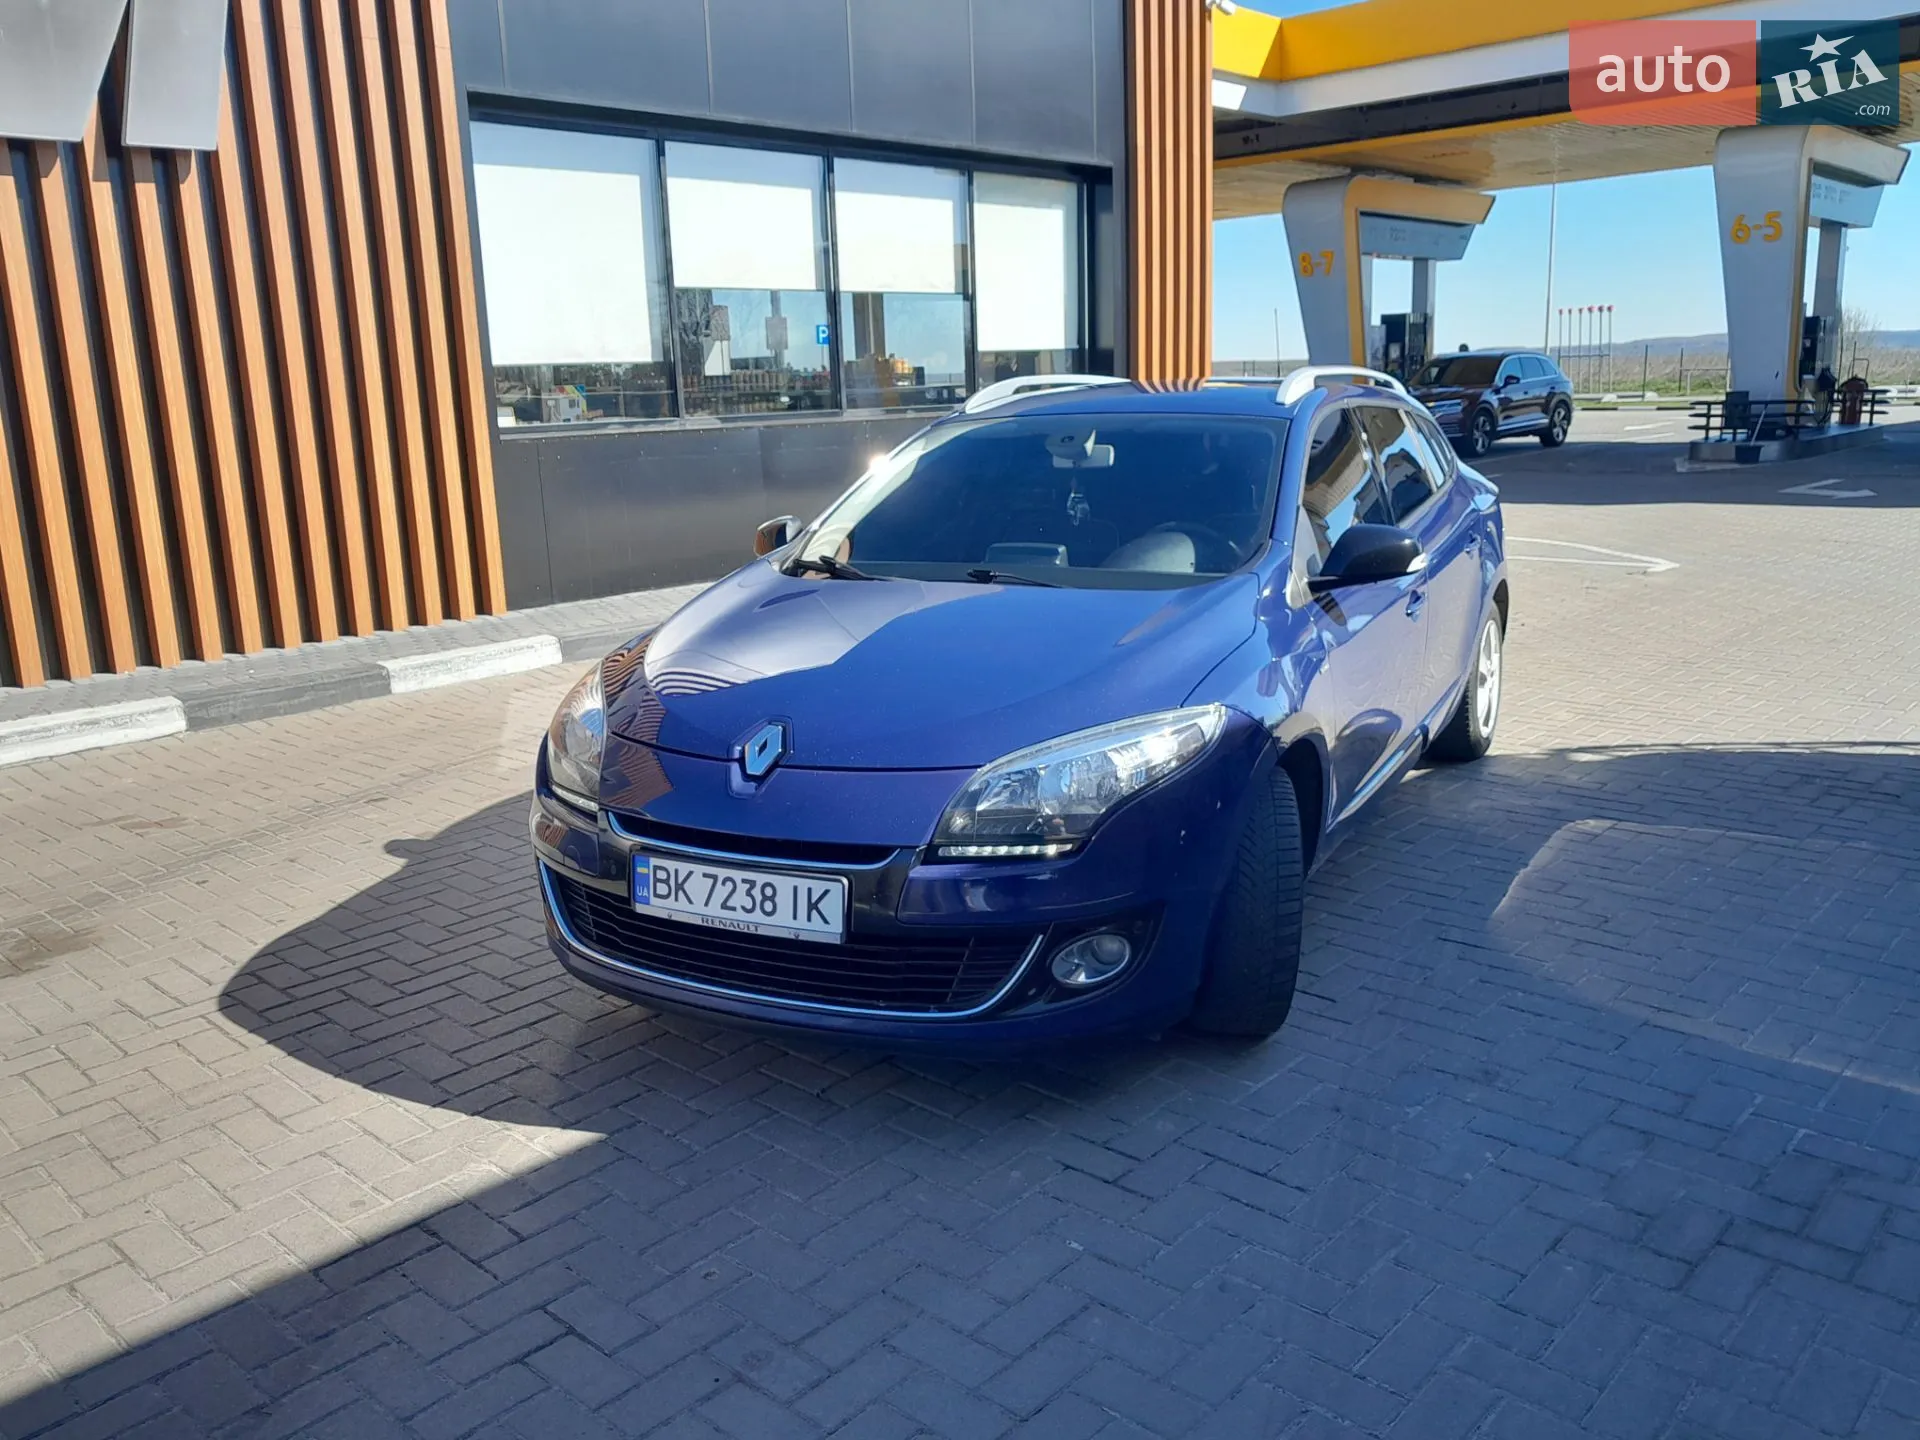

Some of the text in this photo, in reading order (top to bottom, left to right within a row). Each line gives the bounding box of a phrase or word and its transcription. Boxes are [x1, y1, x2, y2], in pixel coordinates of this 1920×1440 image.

[1730, 211, 1783, 244] 6-5
[1298, 251, 1334, 277] 8-7
[819, 326, 829, 344] P
[636, 885, 649, 897] UA
[652, 864, 831, 925] BK 7238 IK
[700, 916, 760, 933] RENAULT
